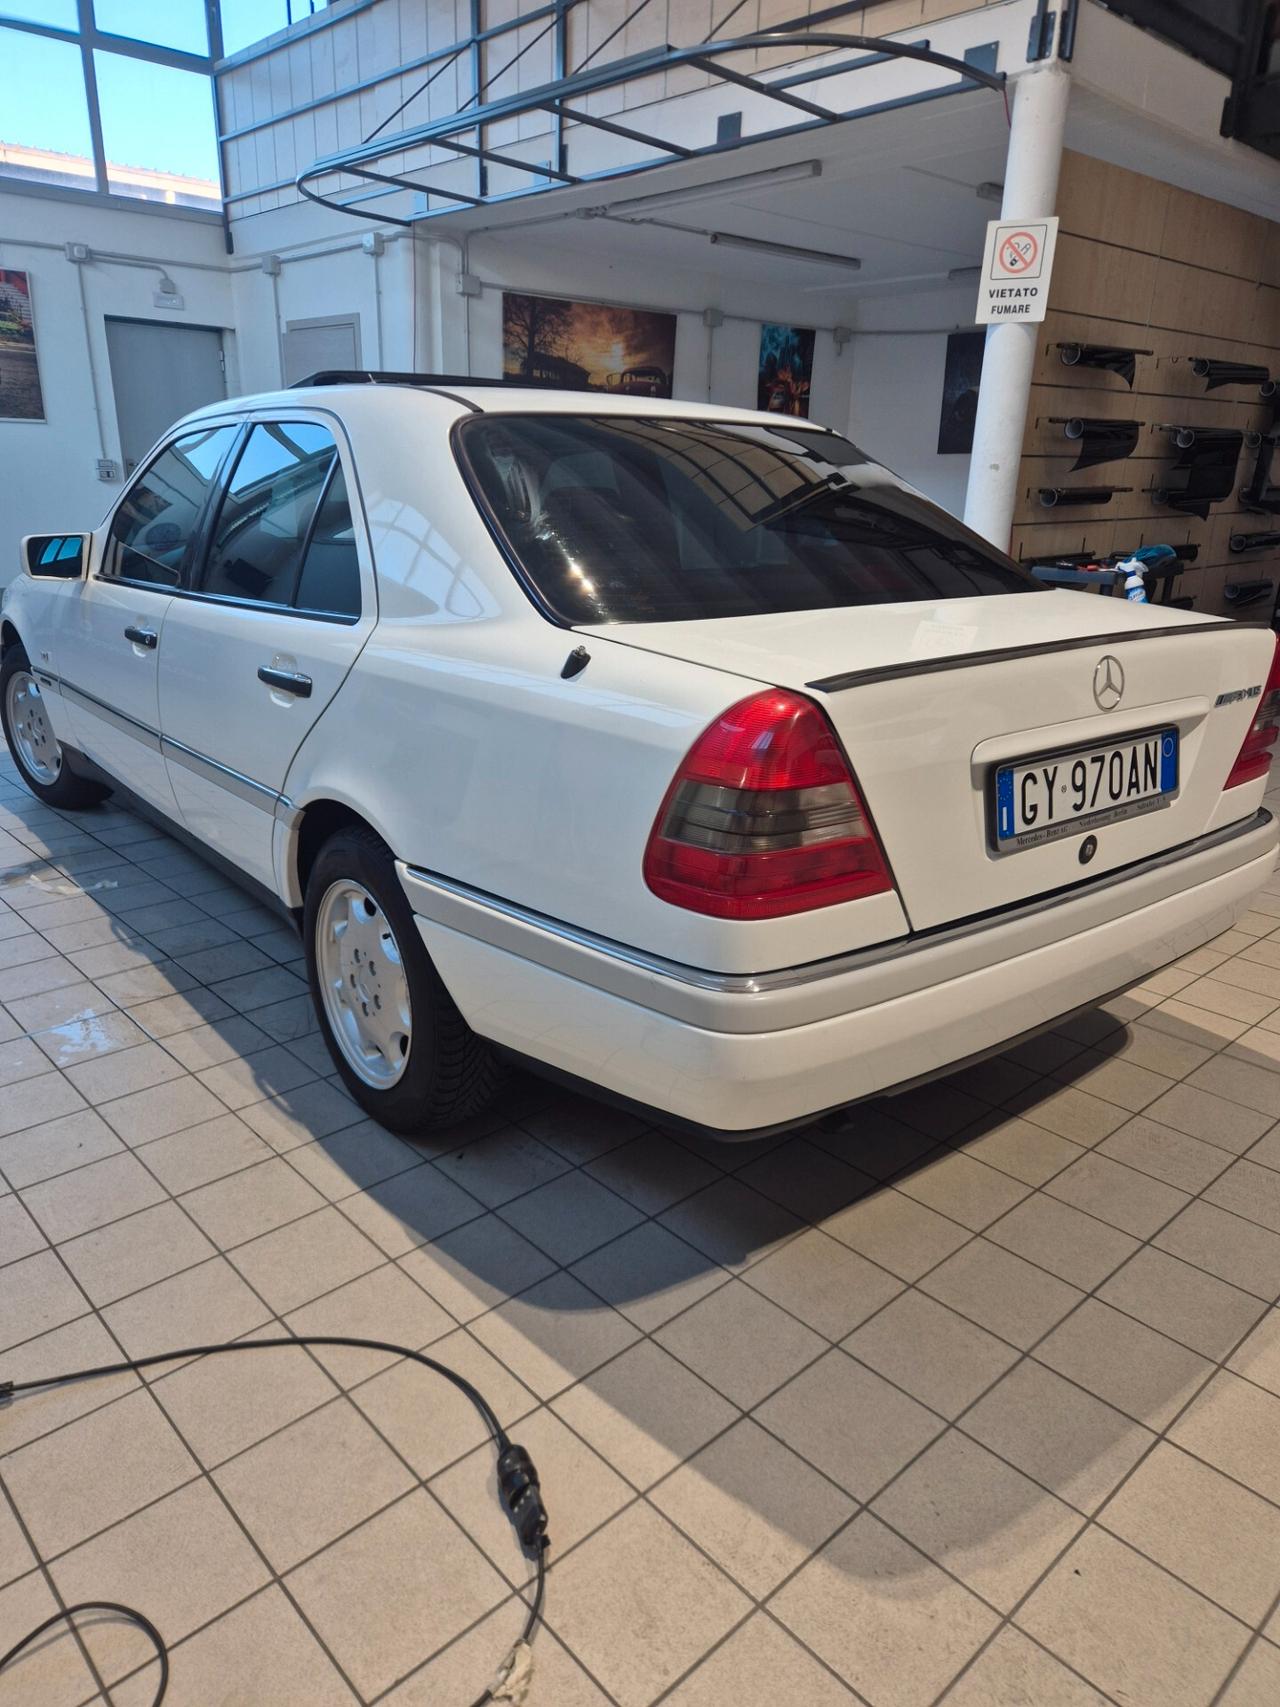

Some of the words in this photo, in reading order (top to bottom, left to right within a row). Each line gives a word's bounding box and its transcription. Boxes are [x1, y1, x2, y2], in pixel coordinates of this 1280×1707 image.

[988, 287, 1038, 299] VIETATO
[990, 304, 1031, 315] FUMARE
[1021, 766, 1058, 826] GY
[1071, 741, 1158, 812] 970AN
